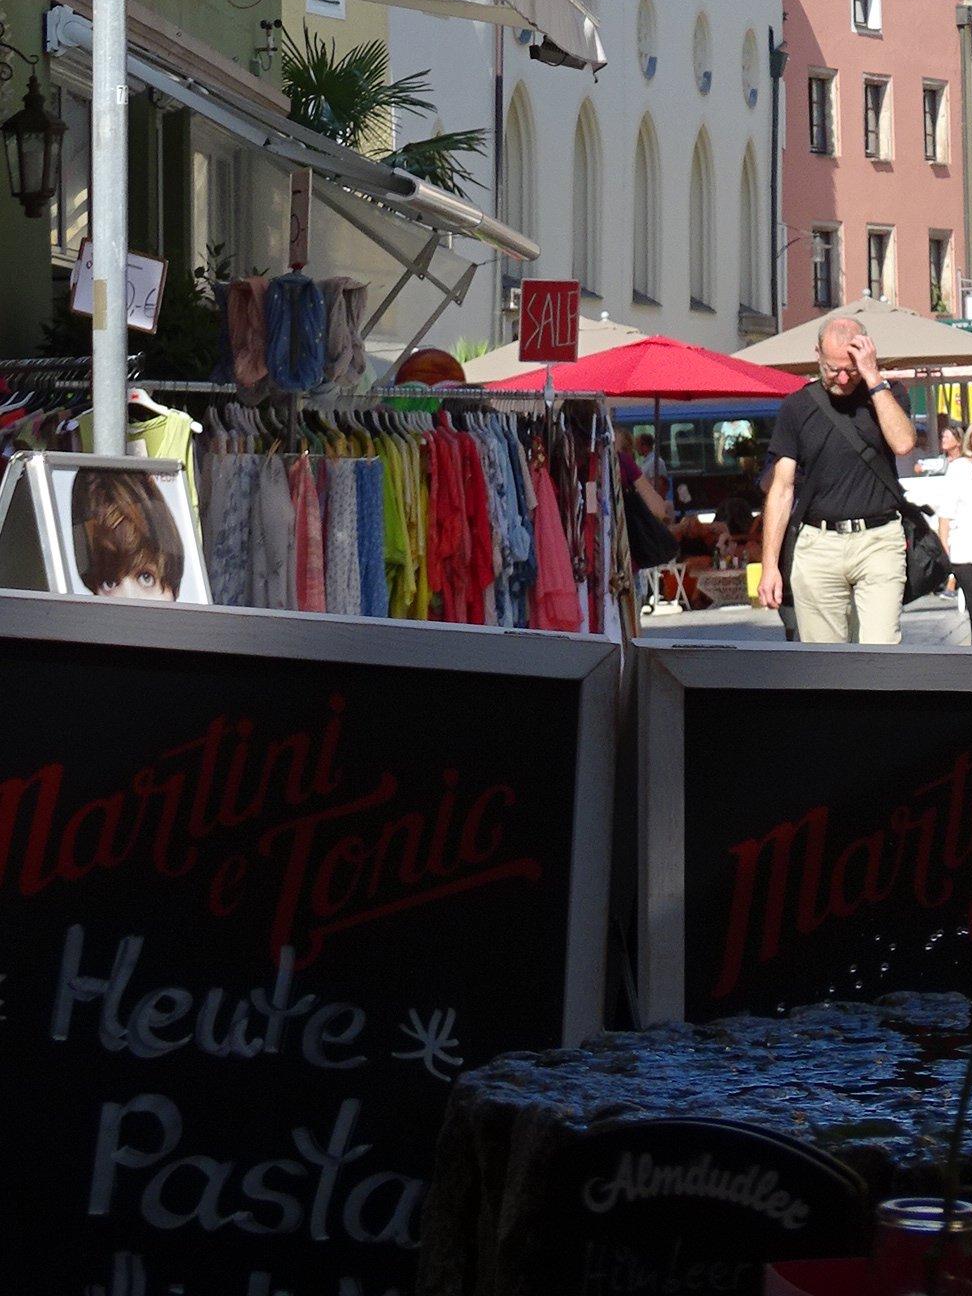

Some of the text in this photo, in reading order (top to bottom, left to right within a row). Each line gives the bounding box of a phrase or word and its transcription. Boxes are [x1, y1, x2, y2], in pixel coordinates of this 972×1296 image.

[524, 290, 578, 350] SALE
[0, 693, 347, 897] Martini
[258, 766, 542, 971] Tonic
[50, 923, 367, 1069] Heute
[87, 1092, 430, 1247] Pasta
[583, 1151, 809, 1229] Almdudler
